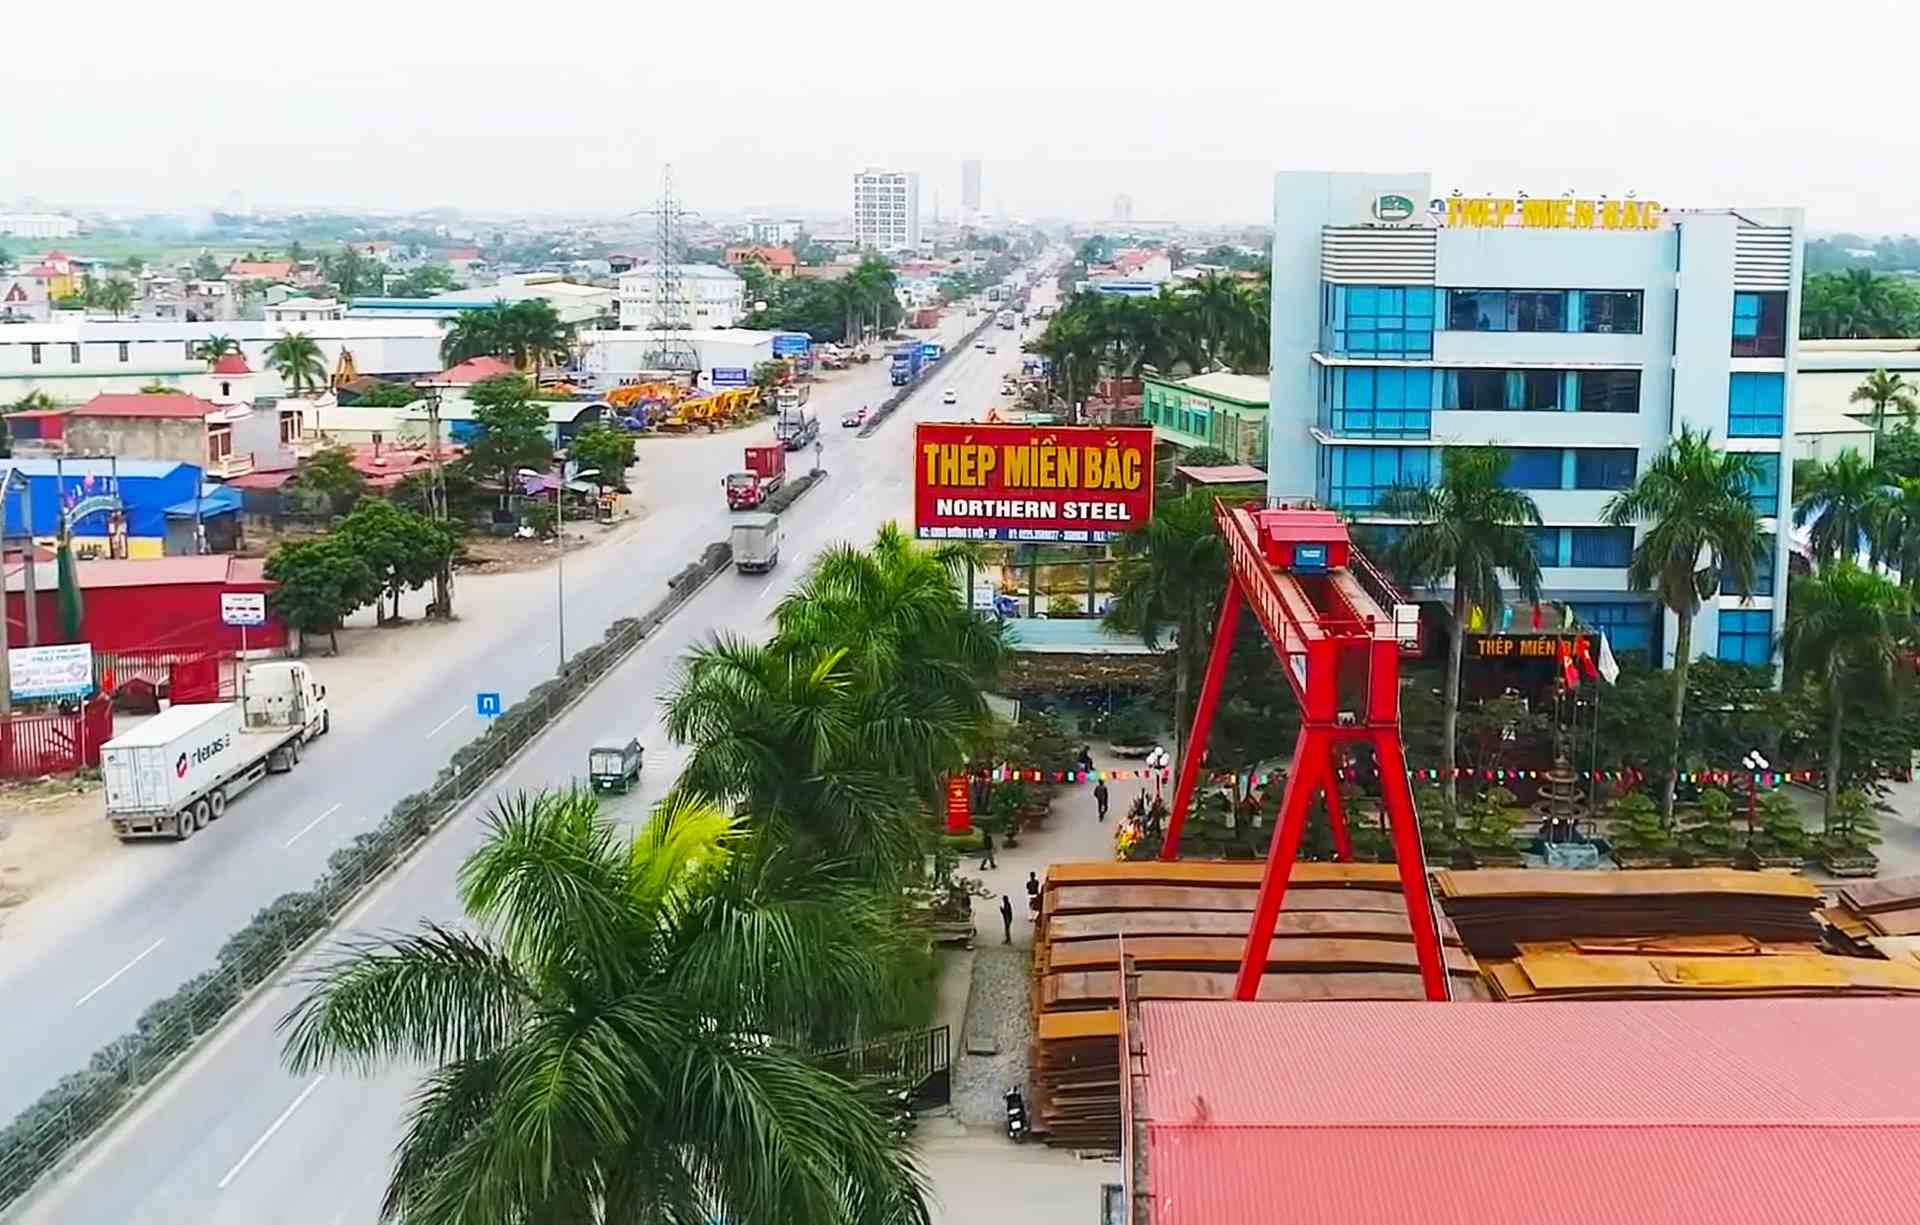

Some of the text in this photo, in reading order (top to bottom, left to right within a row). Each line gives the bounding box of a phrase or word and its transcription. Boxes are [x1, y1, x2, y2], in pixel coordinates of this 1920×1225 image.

[923, 434, 1141, 490] THÉP MIỀN BẮC
[936, 498, 1131, 520] NORTHERN STEEL
[1478, 636, 1514, 655] THÉP
